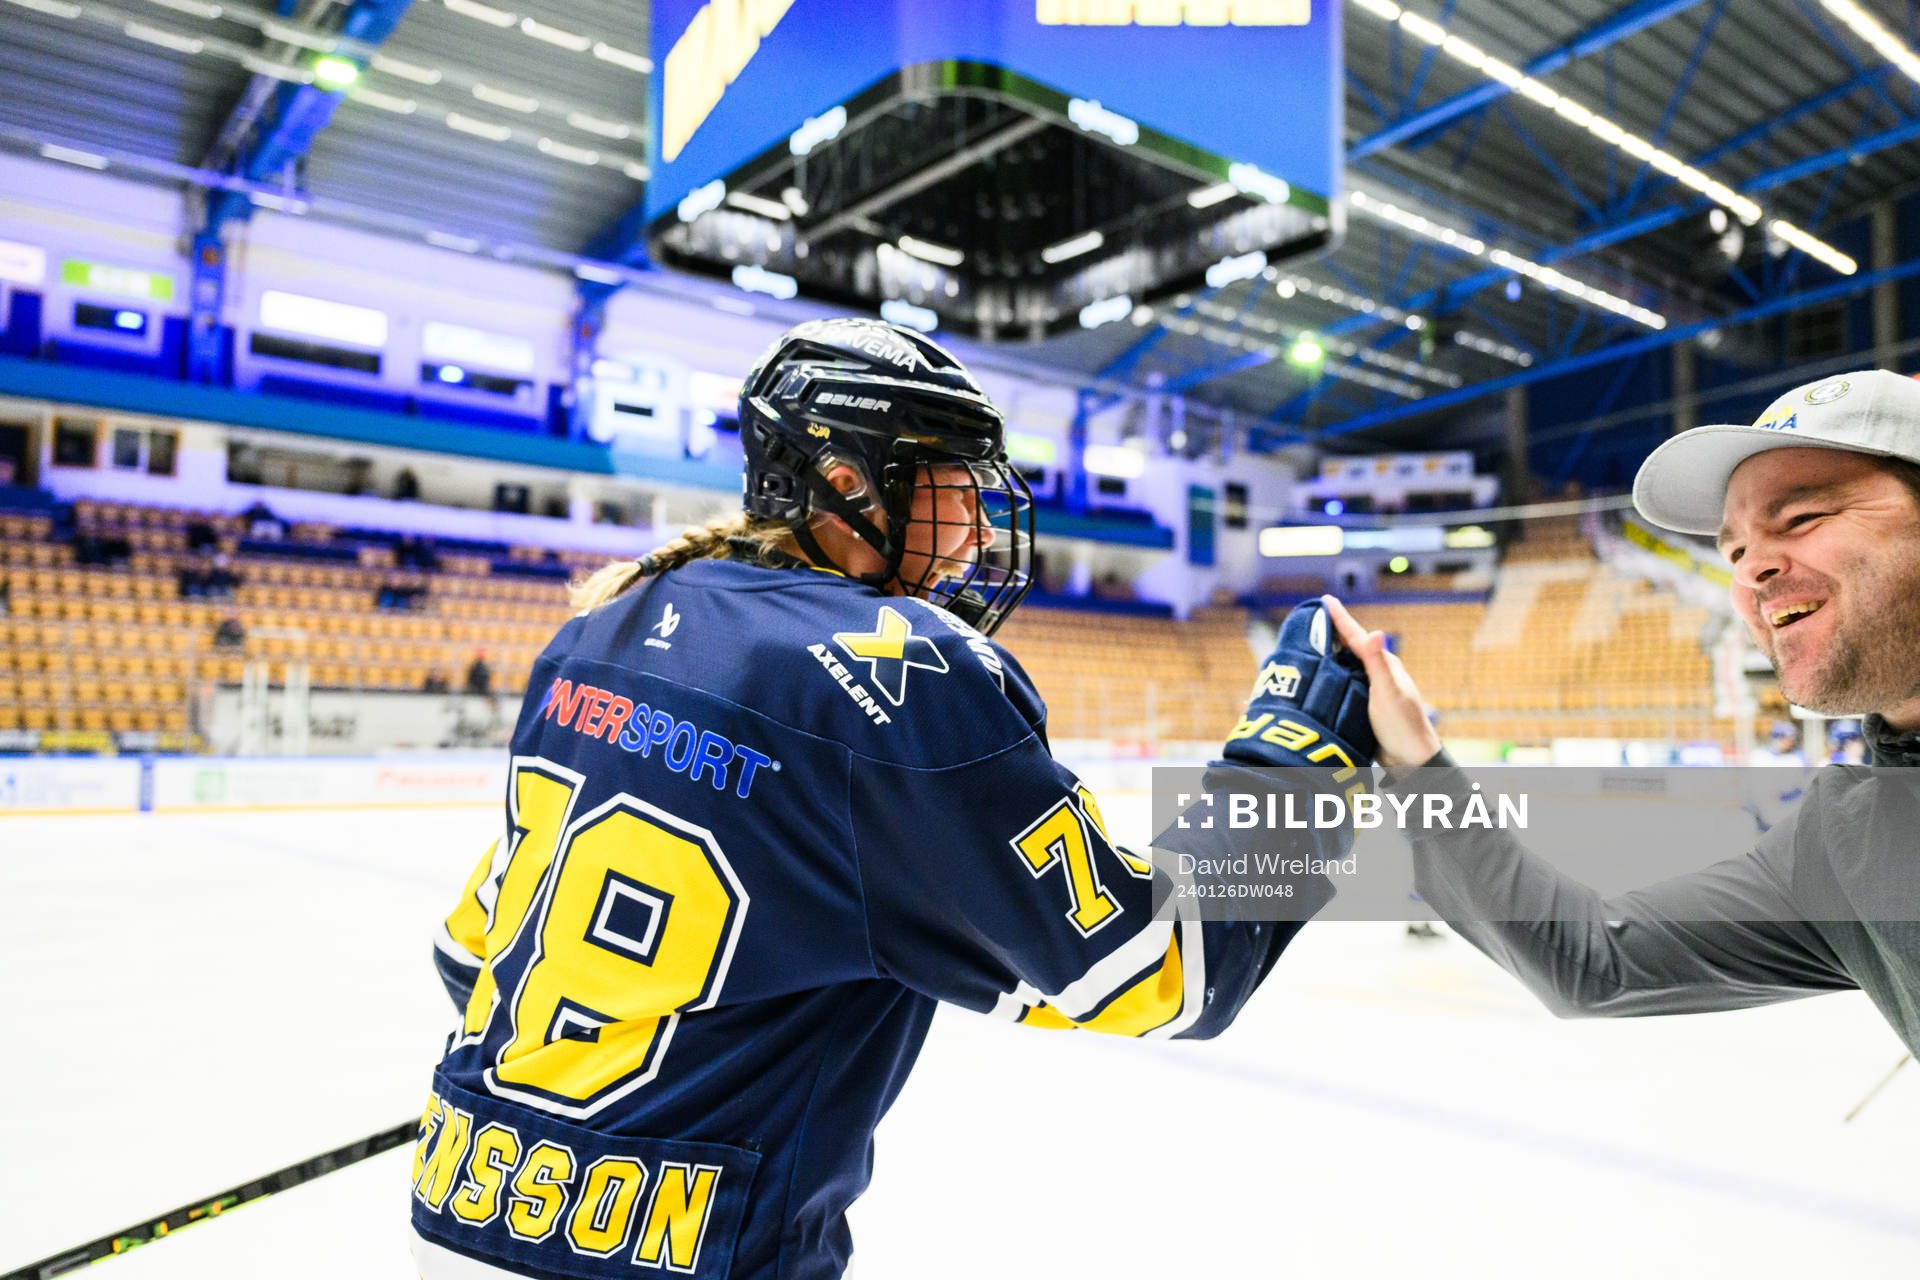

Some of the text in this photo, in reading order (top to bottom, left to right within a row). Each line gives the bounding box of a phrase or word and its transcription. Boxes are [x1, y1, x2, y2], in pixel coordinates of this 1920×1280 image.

[814, 392, 892, 413] BAUER
[806, 643, 892, 727] AXELENT
[447, 756, 750, 1120] 78
